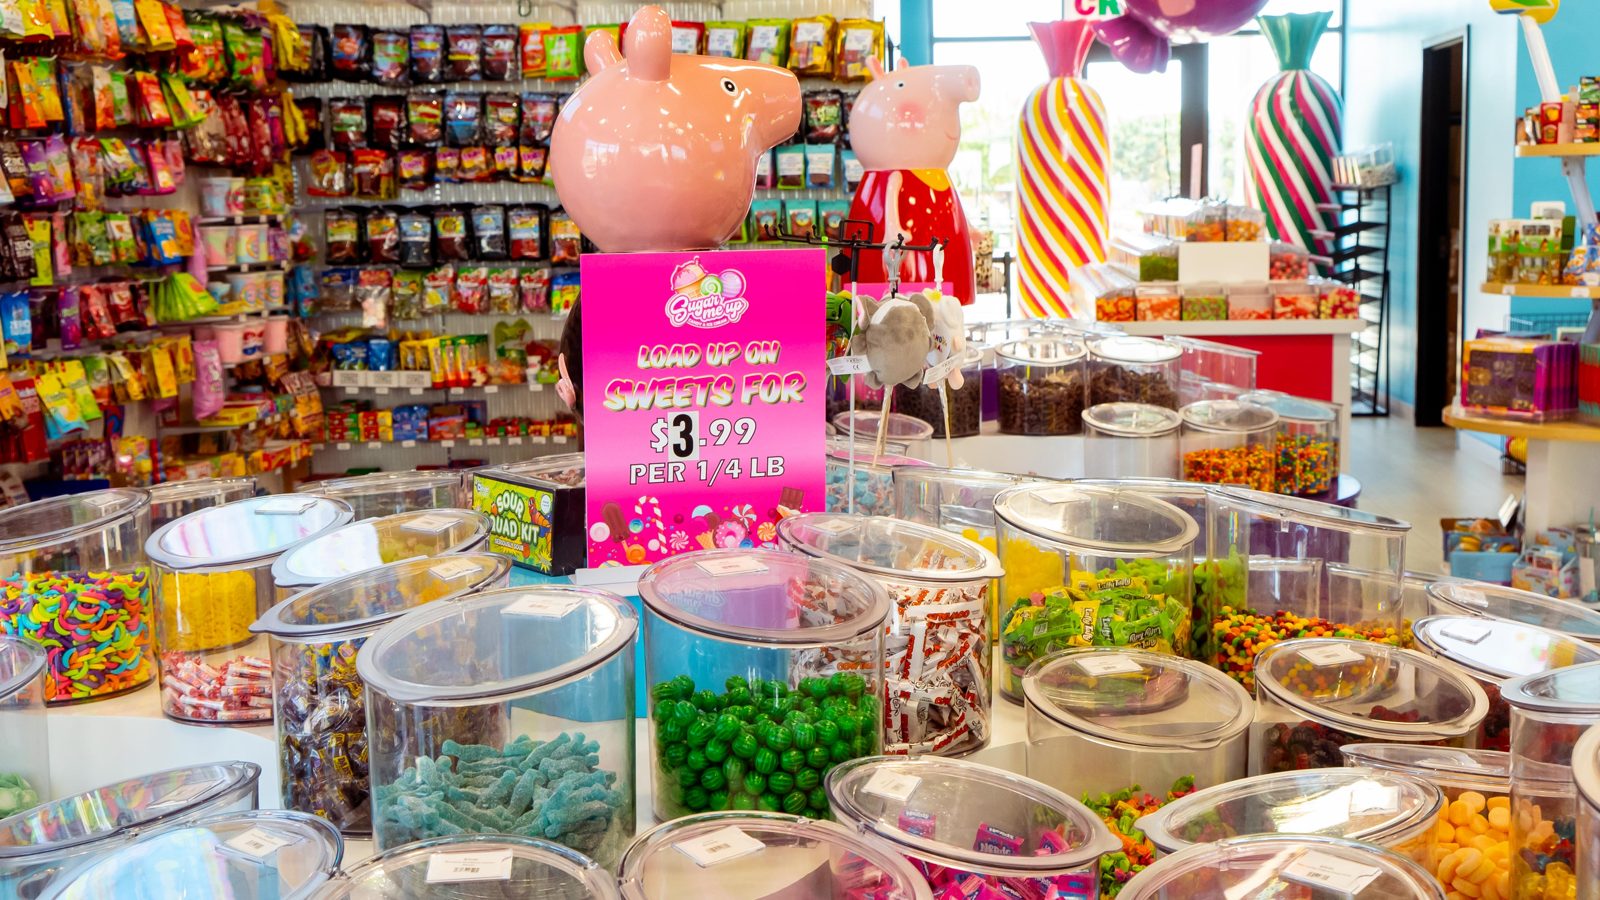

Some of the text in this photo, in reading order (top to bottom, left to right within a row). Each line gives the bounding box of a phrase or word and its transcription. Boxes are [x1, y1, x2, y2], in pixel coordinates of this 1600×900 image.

[670, 295, 724, 321] Sugar
[702, 301, 743, 320] me up
[637, 340, 780, 370] LOAD UP ON
[603, 371, 807, 411] SWEETS FOR
[650, 413, 757, 458] $3.99
[629, 456, 785, 487] PER 1/4 LB
[496, 489, 524, 520] SOUR
[521, 522, 539, 544] KIT
[1082, 608, 1093, 642] Laffy Taffy
